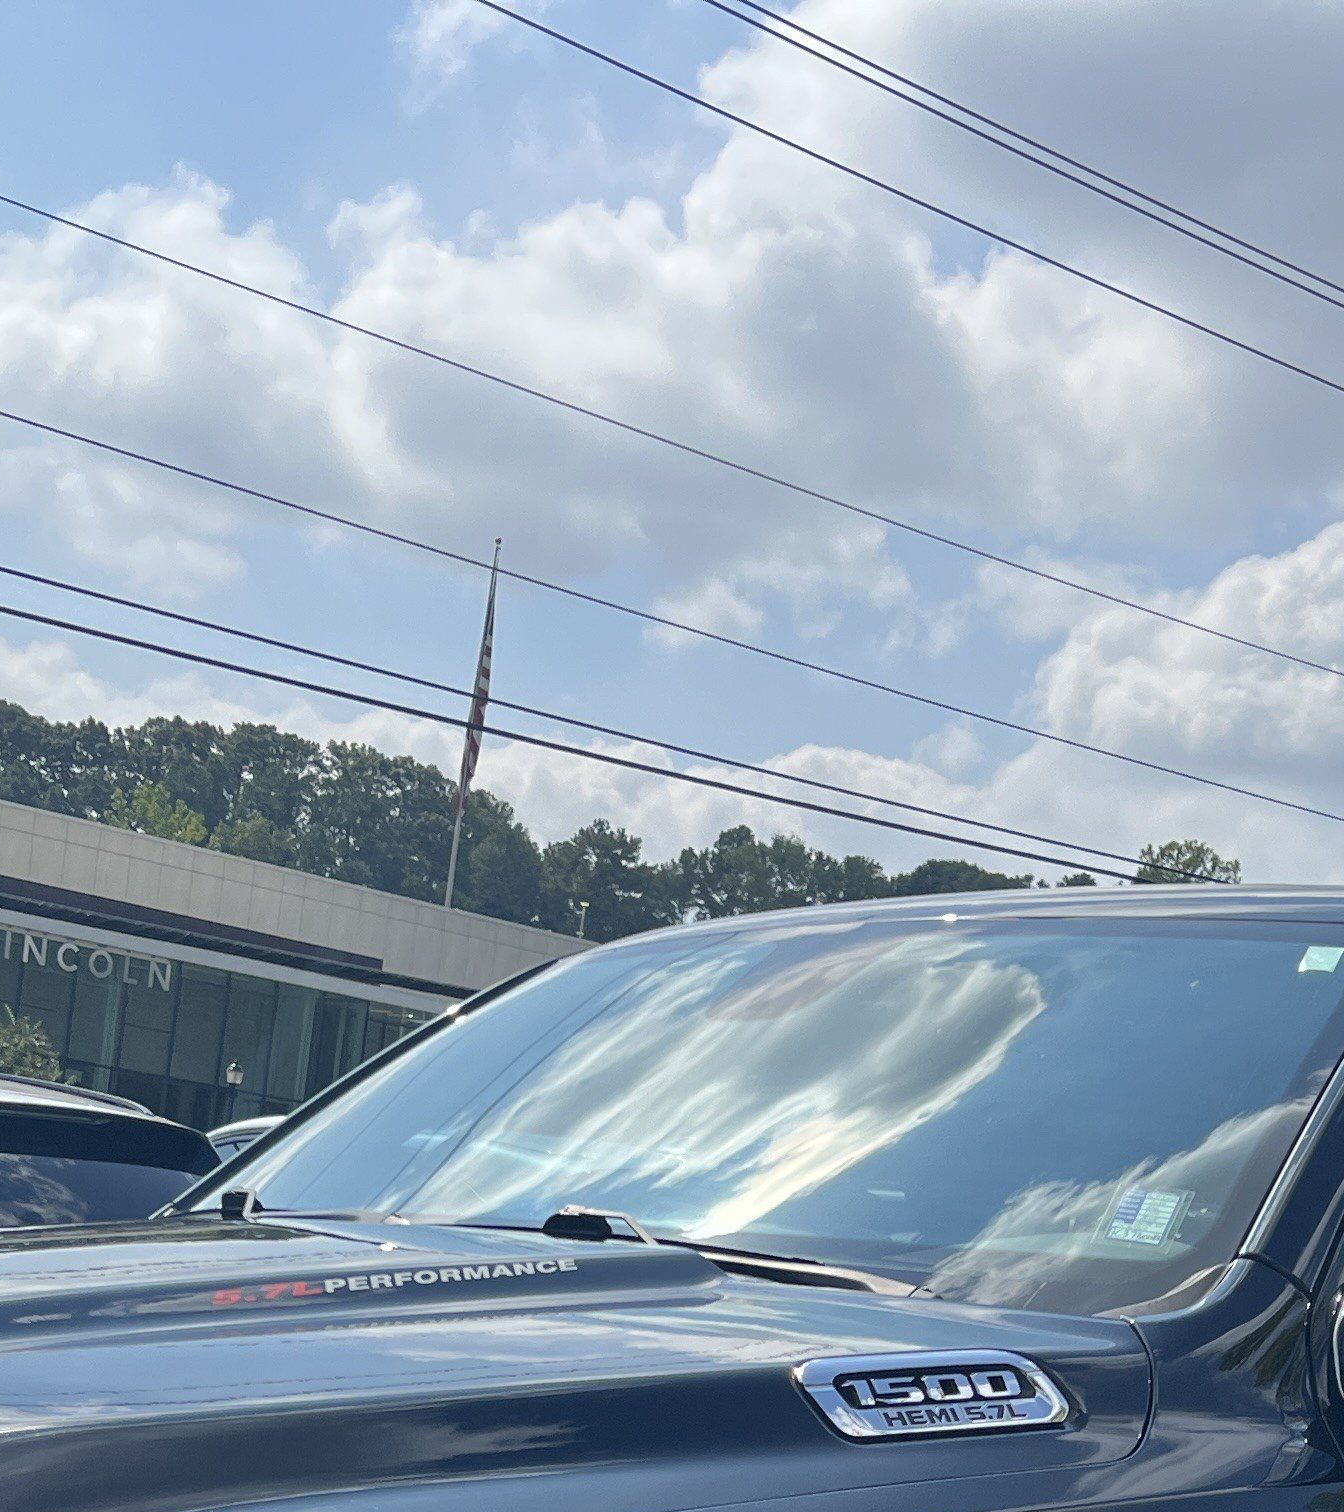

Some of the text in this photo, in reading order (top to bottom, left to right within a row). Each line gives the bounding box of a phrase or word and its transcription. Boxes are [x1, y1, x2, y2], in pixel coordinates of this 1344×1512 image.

[211, 1258, 579, 1306] 5.7L PERFORMANCE
[841, 1370, 1022, 1407] 1500
[882, 1403, 1028, 1428] HEMI 5.7L
